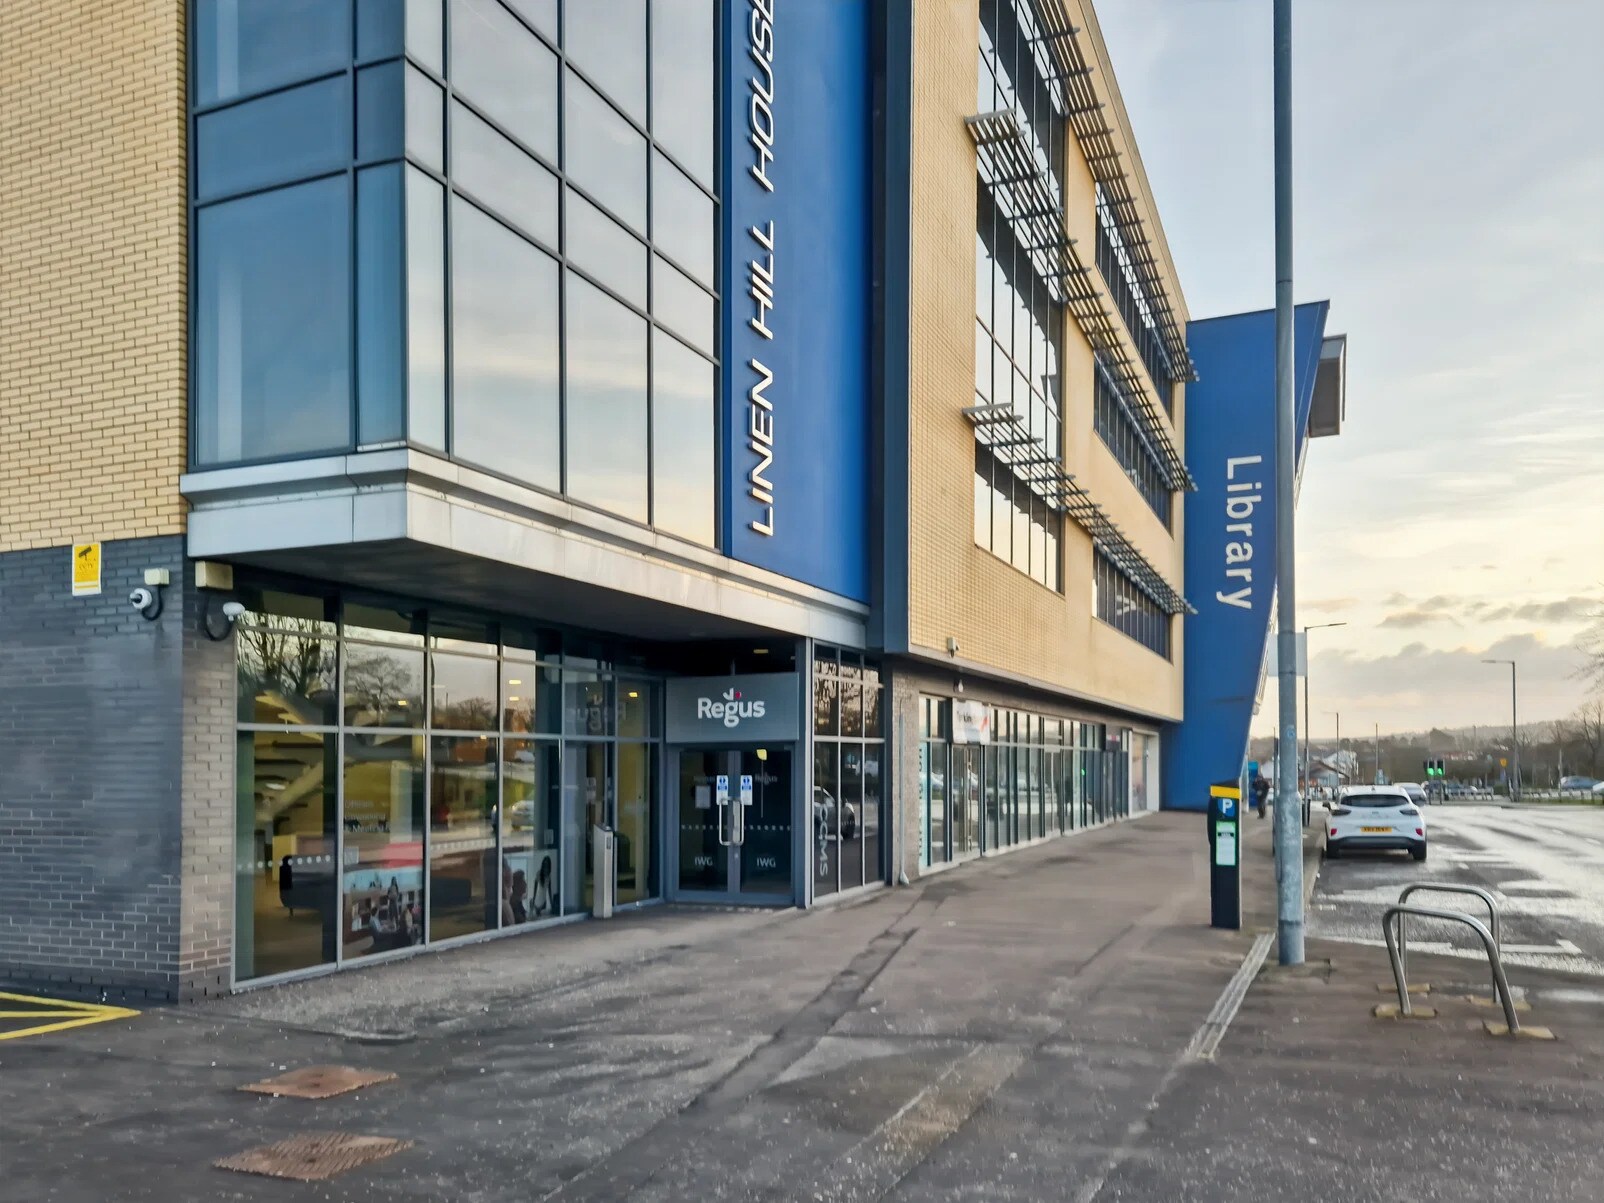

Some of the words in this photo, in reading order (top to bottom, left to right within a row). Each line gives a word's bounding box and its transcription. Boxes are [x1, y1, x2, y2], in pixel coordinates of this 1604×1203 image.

[752, 220, 774, 340] HILL
[752, 358, 773, 537] LINEN
[1216, 455, 1262, 609] Library
[697, 693, 766, 728] Regus
[1222, 798, 1233, 814] P
[694, 856, 714, 866] IWG
[756, 857, 777, 868] IWG
